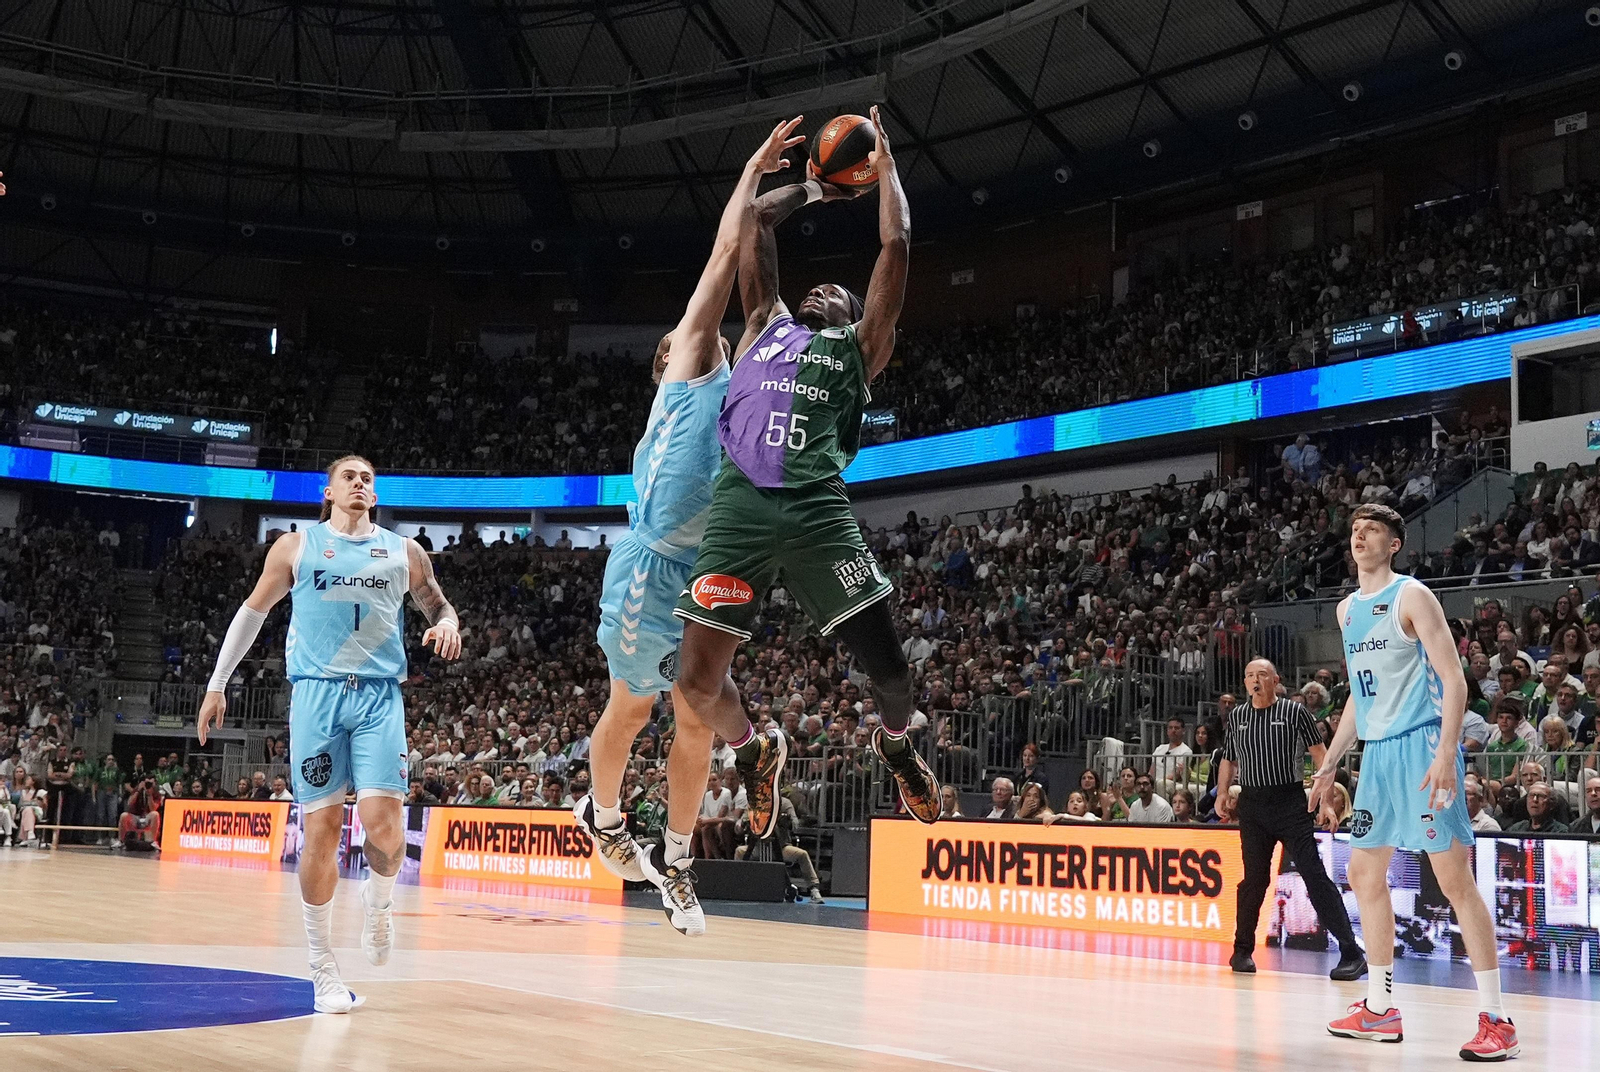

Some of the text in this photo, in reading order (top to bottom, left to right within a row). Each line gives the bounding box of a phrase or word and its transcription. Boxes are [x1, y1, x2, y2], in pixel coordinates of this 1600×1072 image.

[1332, 333, 1361, 345] Unicaa
[784, 350, 844, 372] unicaja
[760, 377, 830, 403] málaga
[54, 411, 85, 424] Unicaja
[55, 404, 97, 416] Fundación
[133, 412, 174, 424] Fundación
[132, 420, 162, 431] Unicaja
[209, 427, 239, 439] Unicaja
[210, 421, 250, 432] Fundación
[765, 411, 809, 450] 55
[331, 575, 390, 590] zunder
[354, 603, 360, 631] 1
[1348, 638, 1389, 654] zunder
[1357, 669, 1377, 698] 12
[180, 809, 271, 838] JOHN PETER FITNESS
[180, 835, 270, 854] TIENDA FITNESS MARBELLA
[444, 819, 593, 858] JOHN PETER FITNESS
[444, 852, 591, 879] TIENDA FITNESS MARBELLA
[921, 838, 1223, 898] JOHN PETER FITNESS
[922, 883, 1221, 929] TIENDA FITNESS MARBELLA
